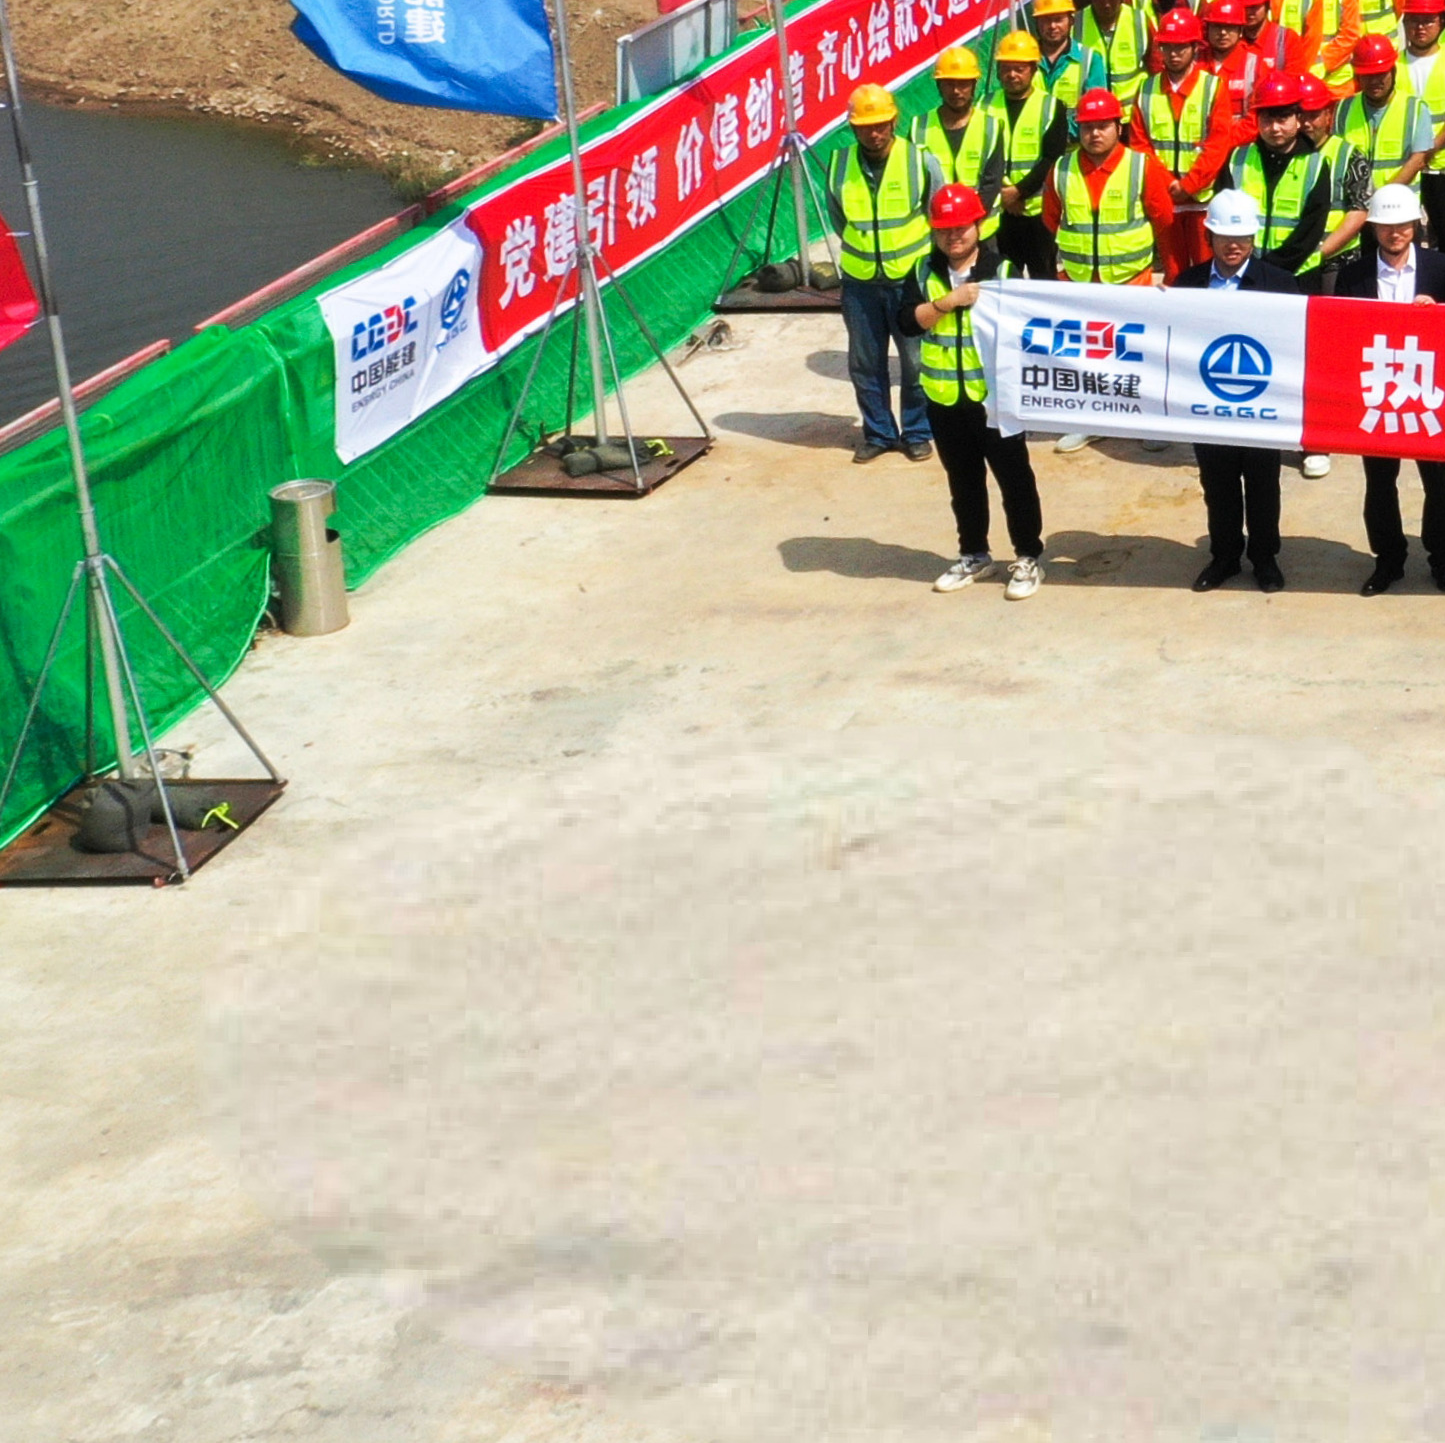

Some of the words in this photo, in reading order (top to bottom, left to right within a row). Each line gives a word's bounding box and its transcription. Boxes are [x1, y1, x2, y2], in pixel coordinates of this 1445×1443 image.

[499, 146, 658, 310] 党建引领
[675, 50, 805, 202] 价值创造
[351, 341, 417, 395] 中国能建
[1021, 364, 1142, 400] 中国能建
[1021, 395, 1086, 411] ENERGY
[1092, 399, 1142, 415] CHINA
[1190, 403, 1279, 421] CGGC
